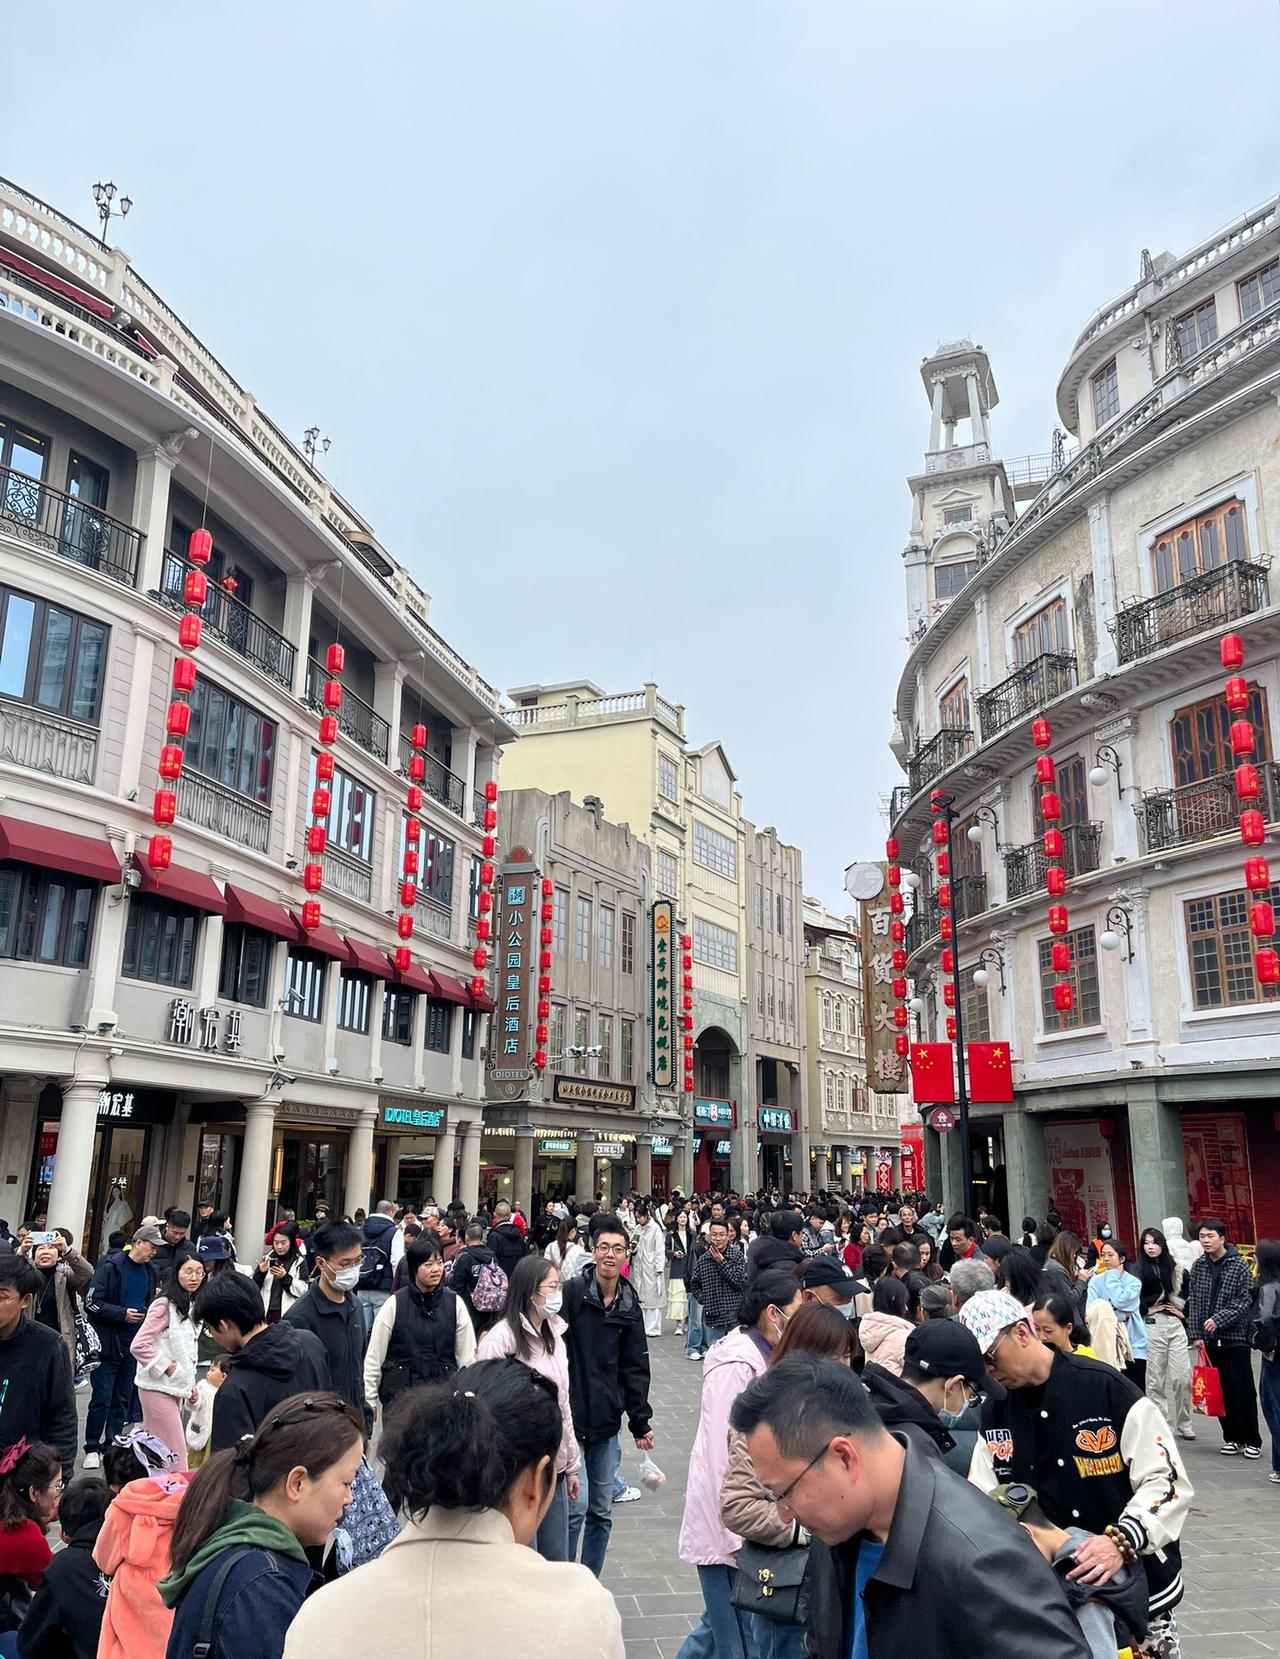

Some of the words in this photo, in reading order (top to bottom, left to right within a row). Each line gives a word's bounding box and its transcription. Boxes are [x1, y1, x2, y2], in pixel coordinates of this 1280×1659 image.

[168, 998, 242, 1052] 潮宏基
[504, 910, 524, 1055] 小公园皇后酒店
